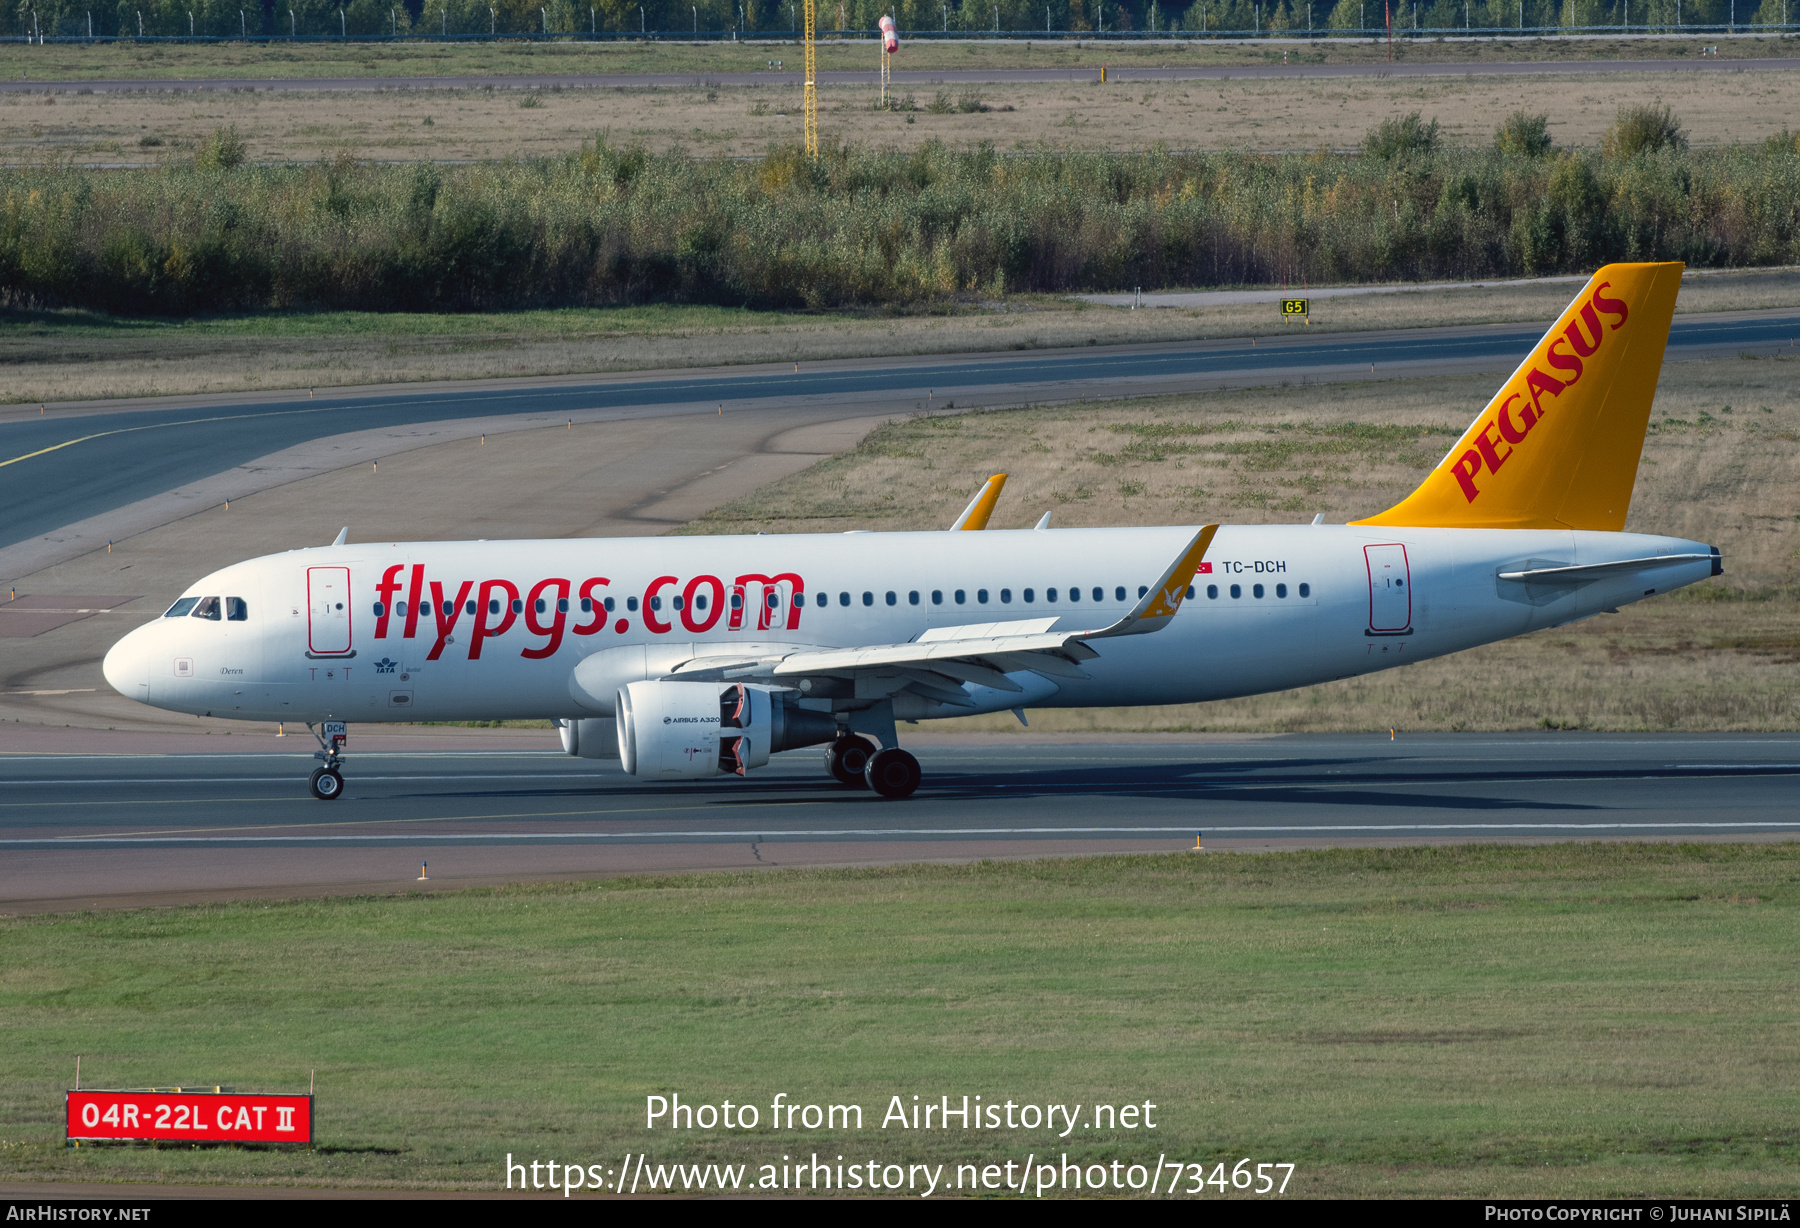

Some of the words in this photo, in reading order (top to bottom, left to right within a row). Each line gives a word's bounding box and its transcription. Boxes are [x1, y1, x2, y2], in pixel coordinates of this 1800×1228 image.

[1286, 302, 1302, 312] G5
[1450, 281, 1629, 504] PEGASUS
[1222, 560, 1287, 574] TC-DCH
[374, 563, 805, 661] flypgs.com
[220, 667, 243, 675] Deren
[672, 716, 699, 724] AIRBUS
[82, 1103, 208, 1130] 04R-22L
[216, 1106, 267, 1131] CAT
[275, 1106, 295, 1132] II
